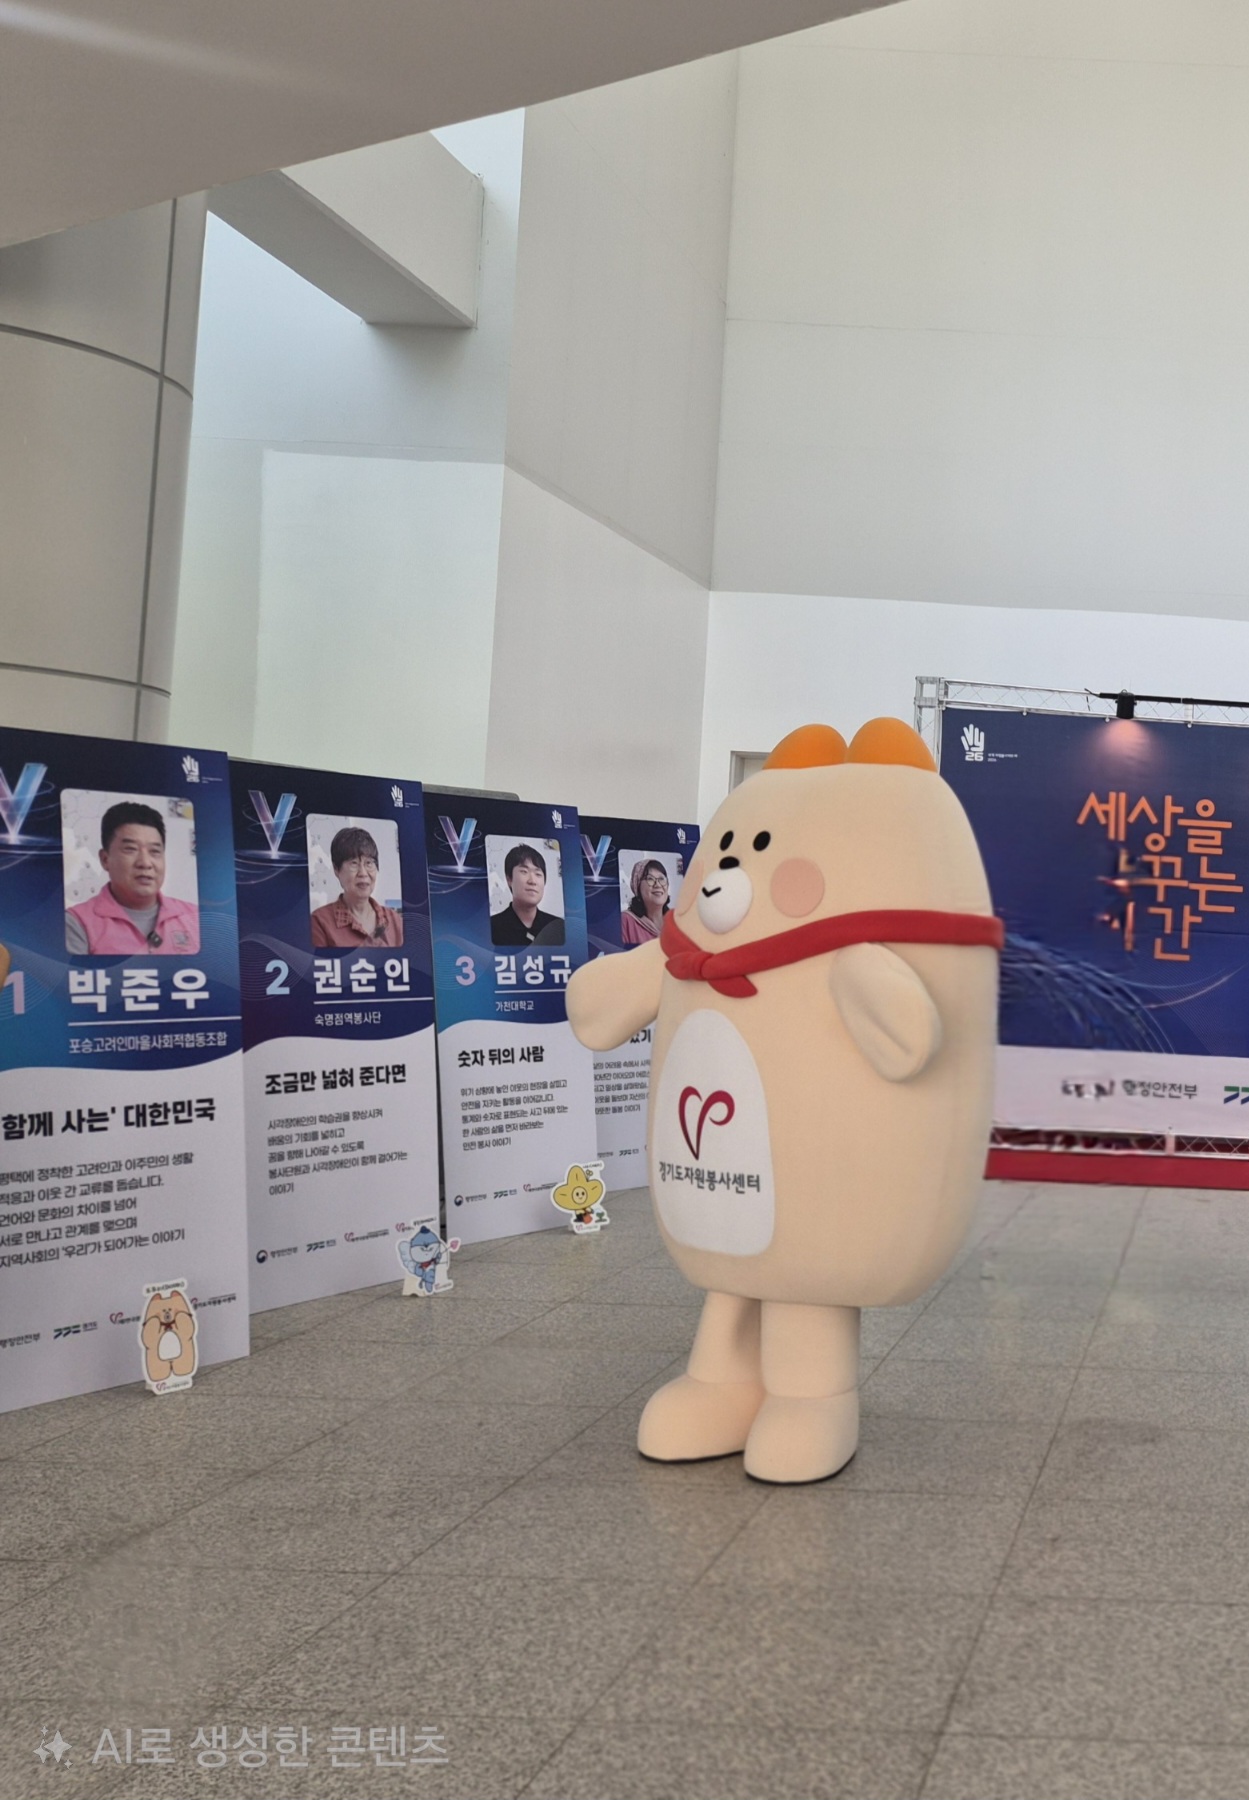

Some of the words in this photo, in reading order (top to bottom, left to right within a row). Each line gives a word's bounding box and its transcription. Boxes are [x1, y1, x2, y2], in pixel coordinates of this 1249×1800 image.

[965, 752, 983, 761] 26
[1076, 791, 1232, 855] 세상을
[265, 960, 290, 995] 2
[313, 958, 410, 994] 권순인
[455, 956, 476, 986] 3
[494, 955, 571, 985] 김성규
[4, 971, 25, 1014] 1
[69, 969, 209, 1012] 박준우
[495, 1001, 534, 1012] 가천대학교
[315, 1012, 381, 1026] 숙명점역봉사단
[69, 1032, 227, 1054] 포승고려인마을사회적협동조합
[458, 1050, 485, 1067] 숫자
[488, 1048, 515, 1065] 뒤의
[519, 1046, 544, 1063] 사람
[265, 1071, 316, 1095] 조금만
[322, 1068, 354, 1090] 넓혀
[359, 1064, 406, 1086] 준다면
[1, 1112, 53, 1140] 함께
[62, 1107, 116, 1133] 사는'
[124, 1098, 215, 1128] 대한민국
[463, 1129, 469, 1137] 한
[471, 1126, 490, 1136] 사람의
[463, 1142, 476, 1151] 안전
[478, 1140, 490, 1149] 봉사
[492, 1137, 511, 1147] 이야기
[0, 1171, 34, 1186] 평택에
[37, 1166, 73, 1181] 정착한
[76, 1160, 122, 1177] 고려인과
[125, 1155, 169, 1171] 이주민의
[172, 1152, 193, 1166] 생활
[269, 1164, 310, 1179] 봉사단원과
[312, 1157, 359, 1173] 시각장애인이
[361, 1155, 376, 1166] 함께
[378, 1151, 407, 1163] 걸어가는
[659, 1162, 760, 1194] 경기도자원봉사센터
[0, 1191, 34, 1205] 적응과
[38, 1188, 61, 1201] 이웃
[65, 1186, 76, 1198] 간
[79, 1181, 113, 1196] 교류를
[117, 1175, 164, 1192] 돕습니다.
[269, 1182, 294, 1195] 이야기
[0, 1211, 34, 1227] 언어와
[38, 1206, 73, 1222] 문화의
[77, 1200, 111, 1216] 차이를
[114, 1197, 137, 1211] 넘어
[0, 1233, 23, 1247] 서로
[26, 1227, 62, 1244] 만나고
[65, 1222, 99, 1238] 관계를
[103, 1217, 137, 1232] 맺으며
[0, 1248, 59, 1268] 지역사회의
[104, 1234, 149, 1252] 되어가는
[152, 1229, 185, 1244] 이야기
